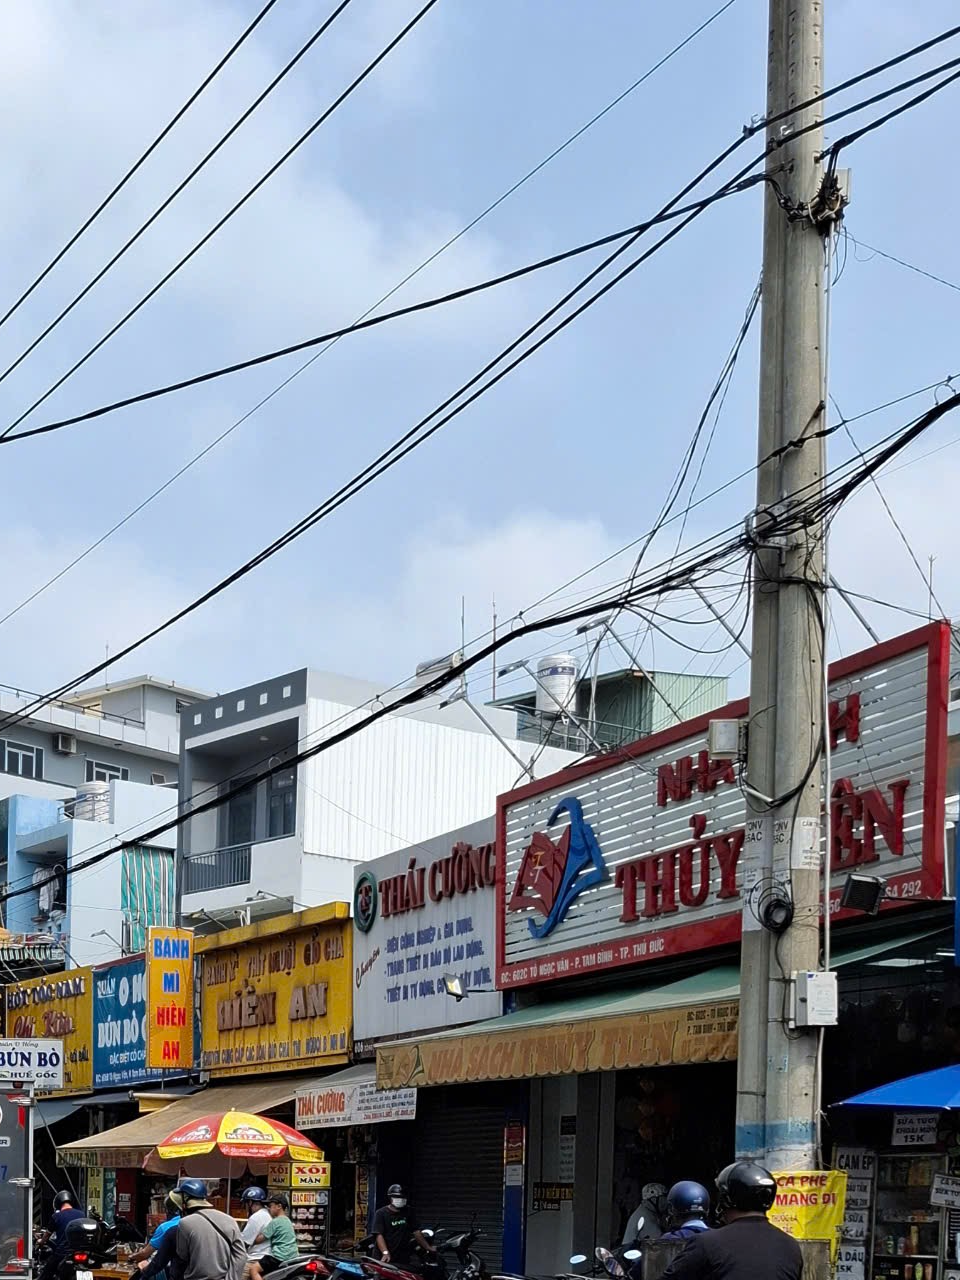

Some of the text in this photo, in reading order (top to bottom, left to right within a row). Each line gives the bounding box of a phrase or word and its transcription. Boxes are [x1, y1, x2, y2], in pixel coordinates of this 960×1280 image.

[614, 813, 746, 923] THỦY
[378, 841, 497, 918] THÁI CƯỜNG
[902, 880, 922, 897] 292
[153, 936, 190, 958] BÁNH
[512, 970, 528, 982] 602C
[582, 954, 596, 967] TAM
[56, 976, 86, 1000] NAM
[163, 970, 180, 993] MÌ
[289, 981, 329, 1021] AN
[156, 1000, 187, 1027] HIỀN
[97, 1014, 121, 1048] BÚN
[123, 1009, 139, 1045] BÒ
[37, 1047, 60, 1067] BÒ
[162, 1041, 180, 1061] AN
[10, 1070, 33, 1078] HUẾ
[35, 1070, 58, 1078] GỐC
[297, 1094, 315, 1117] THÁI
[316, 1088, 346, 1114] CƯỜNG
[904, 1134, 925, 1143] 15K
[295, 1164, 328, 1174] XÔI
[839, 1155, 860, 1170] CAM
[800, 1174, 828, 1187] PHÊ
[775, 1193, 818, 1206] MANG
